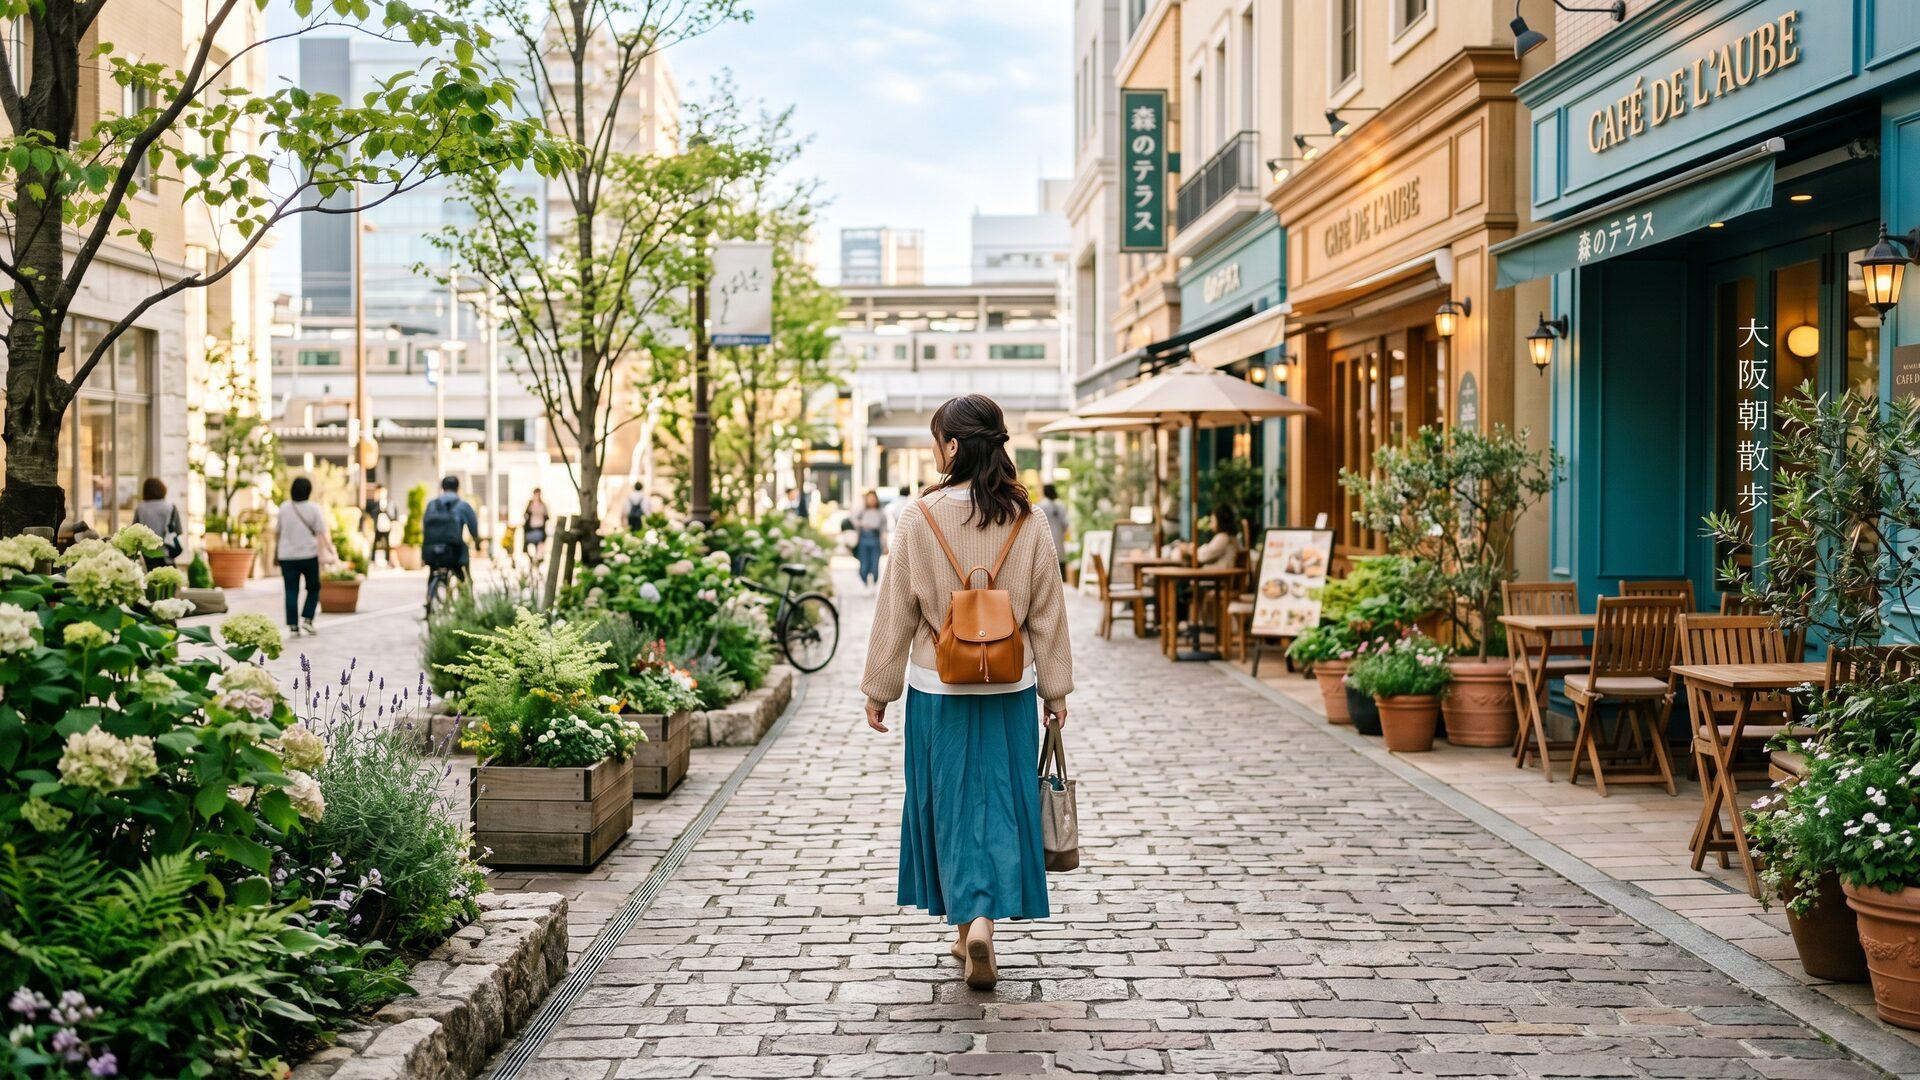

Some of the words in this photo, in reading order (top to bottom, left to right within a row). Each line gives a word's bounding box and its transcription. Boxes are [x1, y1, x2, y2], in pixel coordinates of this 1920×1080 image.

[1588, 75, 1646, 154] CAFÉ
[1650, 67, 1687, 127] DE
[1691, 10, 1801, 108] L'AUBE
[1131, 105, 1157, 232] 森のテラス
[1354, 204, 1370, 245] DE
[1373, 176, 1421, 236] L'AUBE
[1577, 211, 1655, 262] 森のテラス
